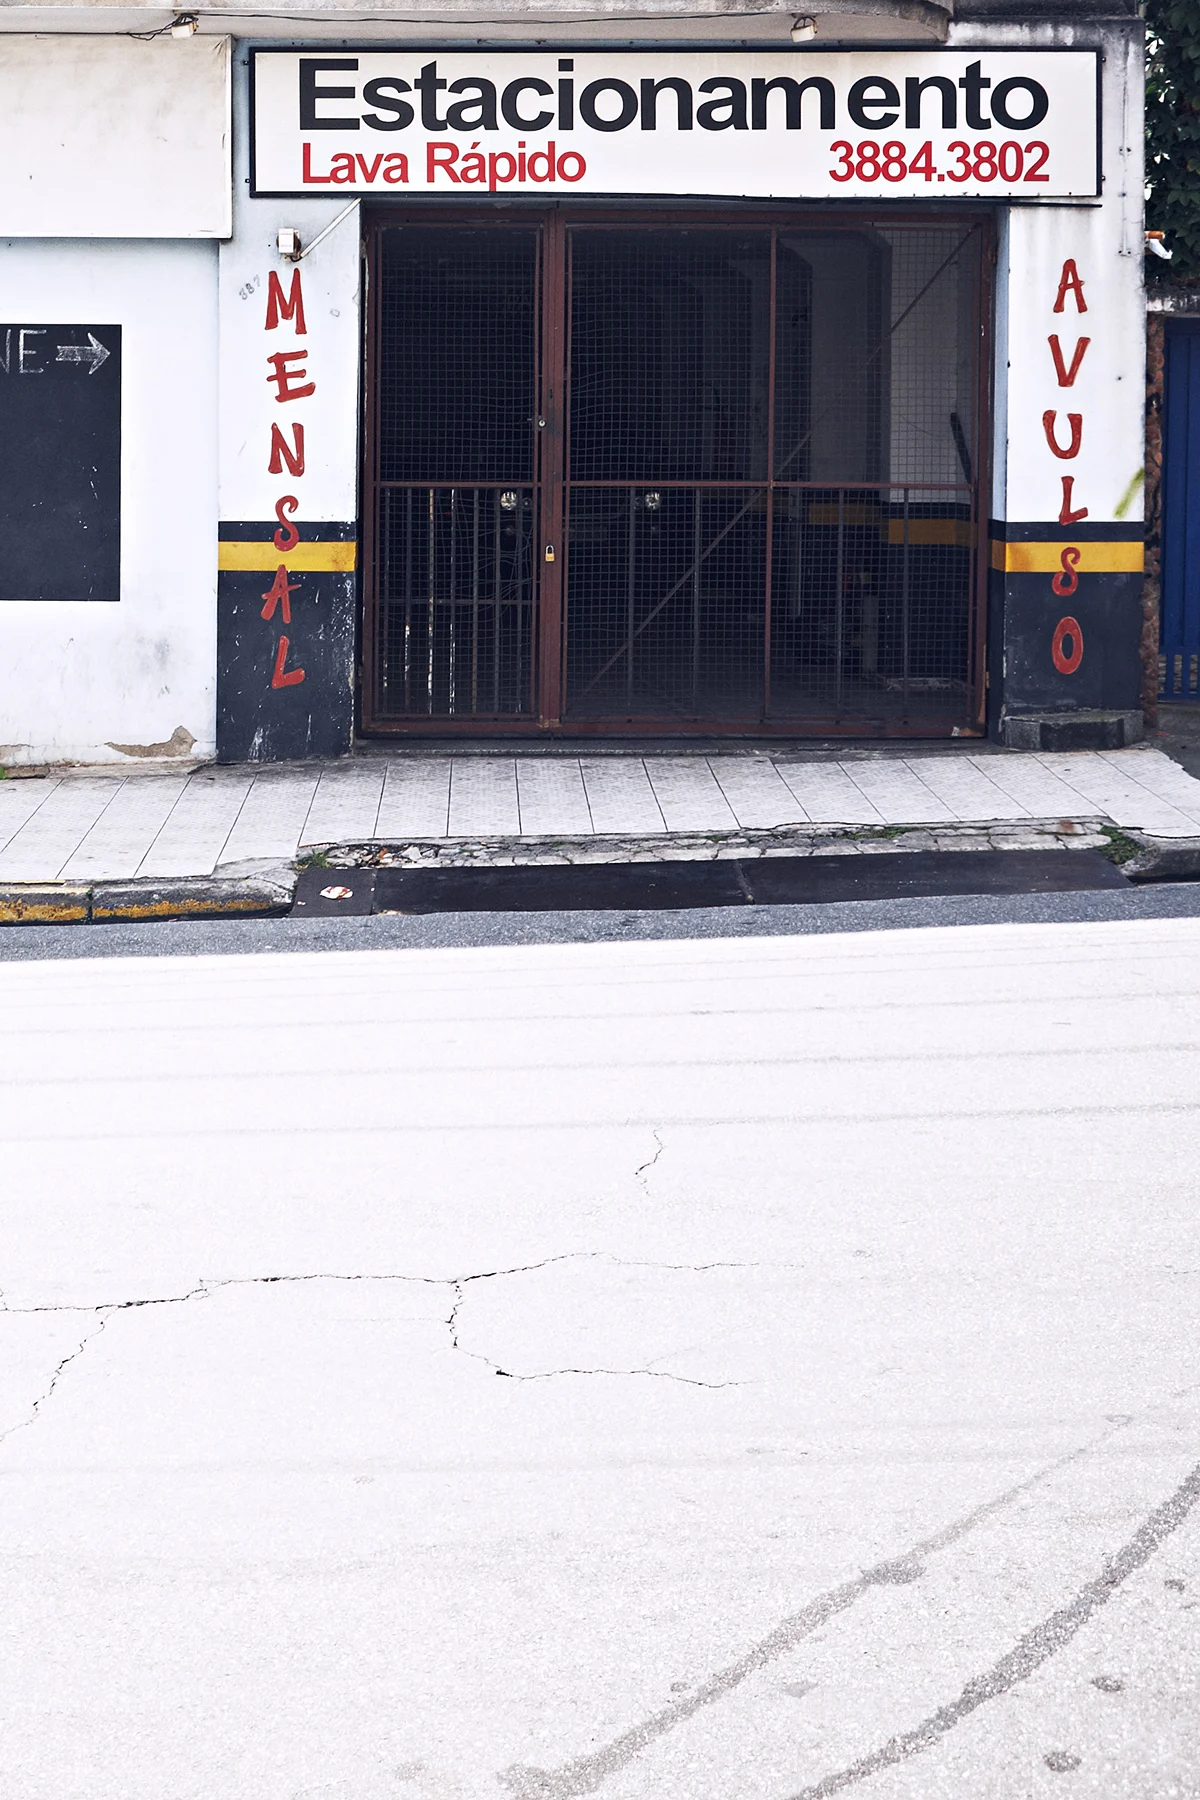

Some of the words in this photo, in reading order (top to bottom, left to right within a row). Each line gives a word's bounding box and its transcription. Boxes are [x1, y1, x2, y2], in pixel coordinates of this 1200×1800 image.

[298, 57, 1049, 133] Estacionamento
[302, 142, 409, 185] Lava
[426, 140, 587, 193] Rápido
[828, 139, 1051, 183] 3884.3802
[261, 267, 316, 689] MENSAL
[1043, 258, 1091, 675] AVULSO
